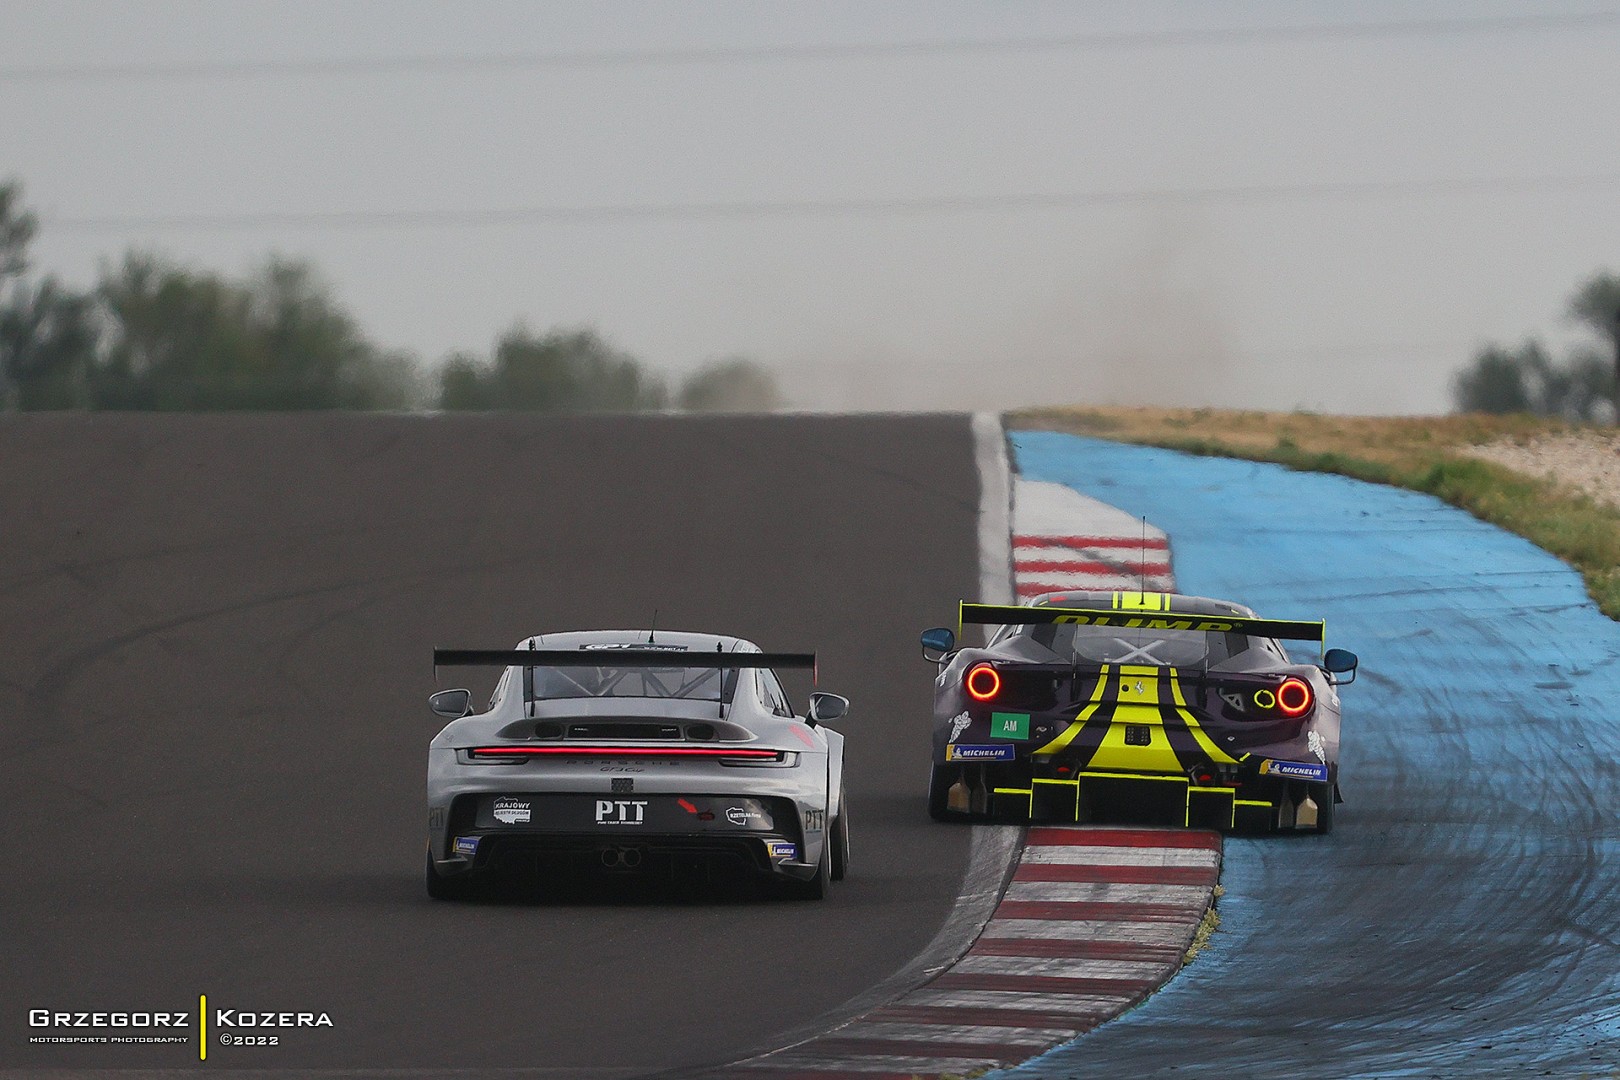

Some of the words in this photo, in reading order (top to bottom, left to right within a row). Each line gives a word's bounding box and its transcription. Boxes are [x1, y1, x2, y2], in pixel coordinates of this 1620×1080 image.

[1004, 720, 1018, 732] AM
[963, 749, 1005, 757] MICHELIN
[1281, 766, 1321, 776] MICHELIN
[596, 800, 648, 821] PTT
